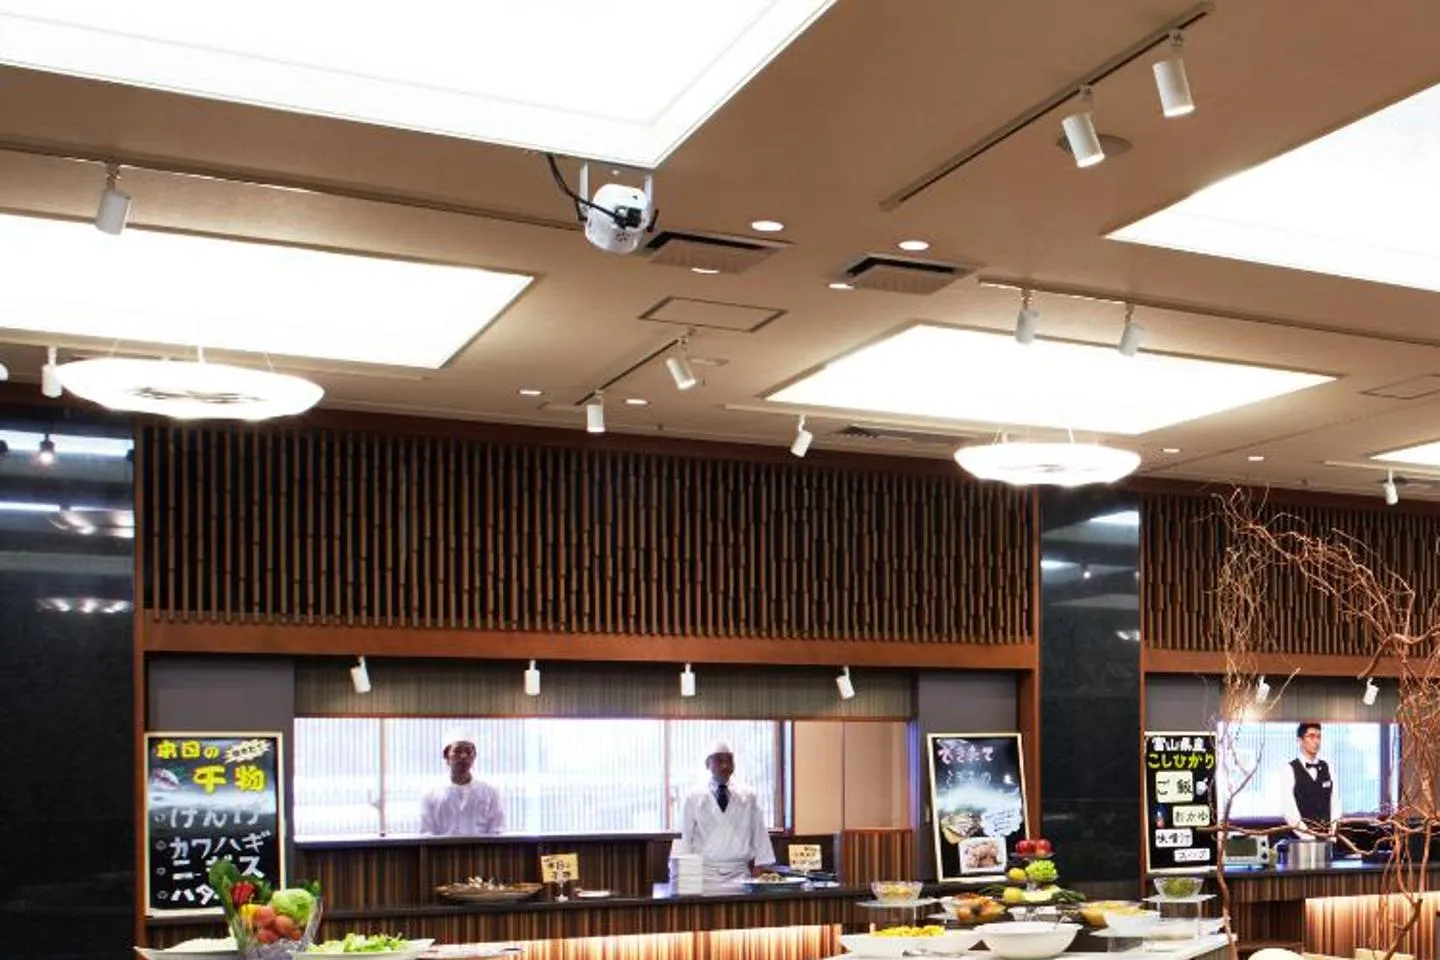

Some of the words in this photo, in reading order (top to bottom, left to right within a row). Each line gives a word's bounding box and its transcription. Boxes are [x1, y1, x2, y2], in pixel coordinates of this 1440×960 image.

[1148, 753, 1214, 769] こしひかり
[169, 830, 271, 859] カワハギ
